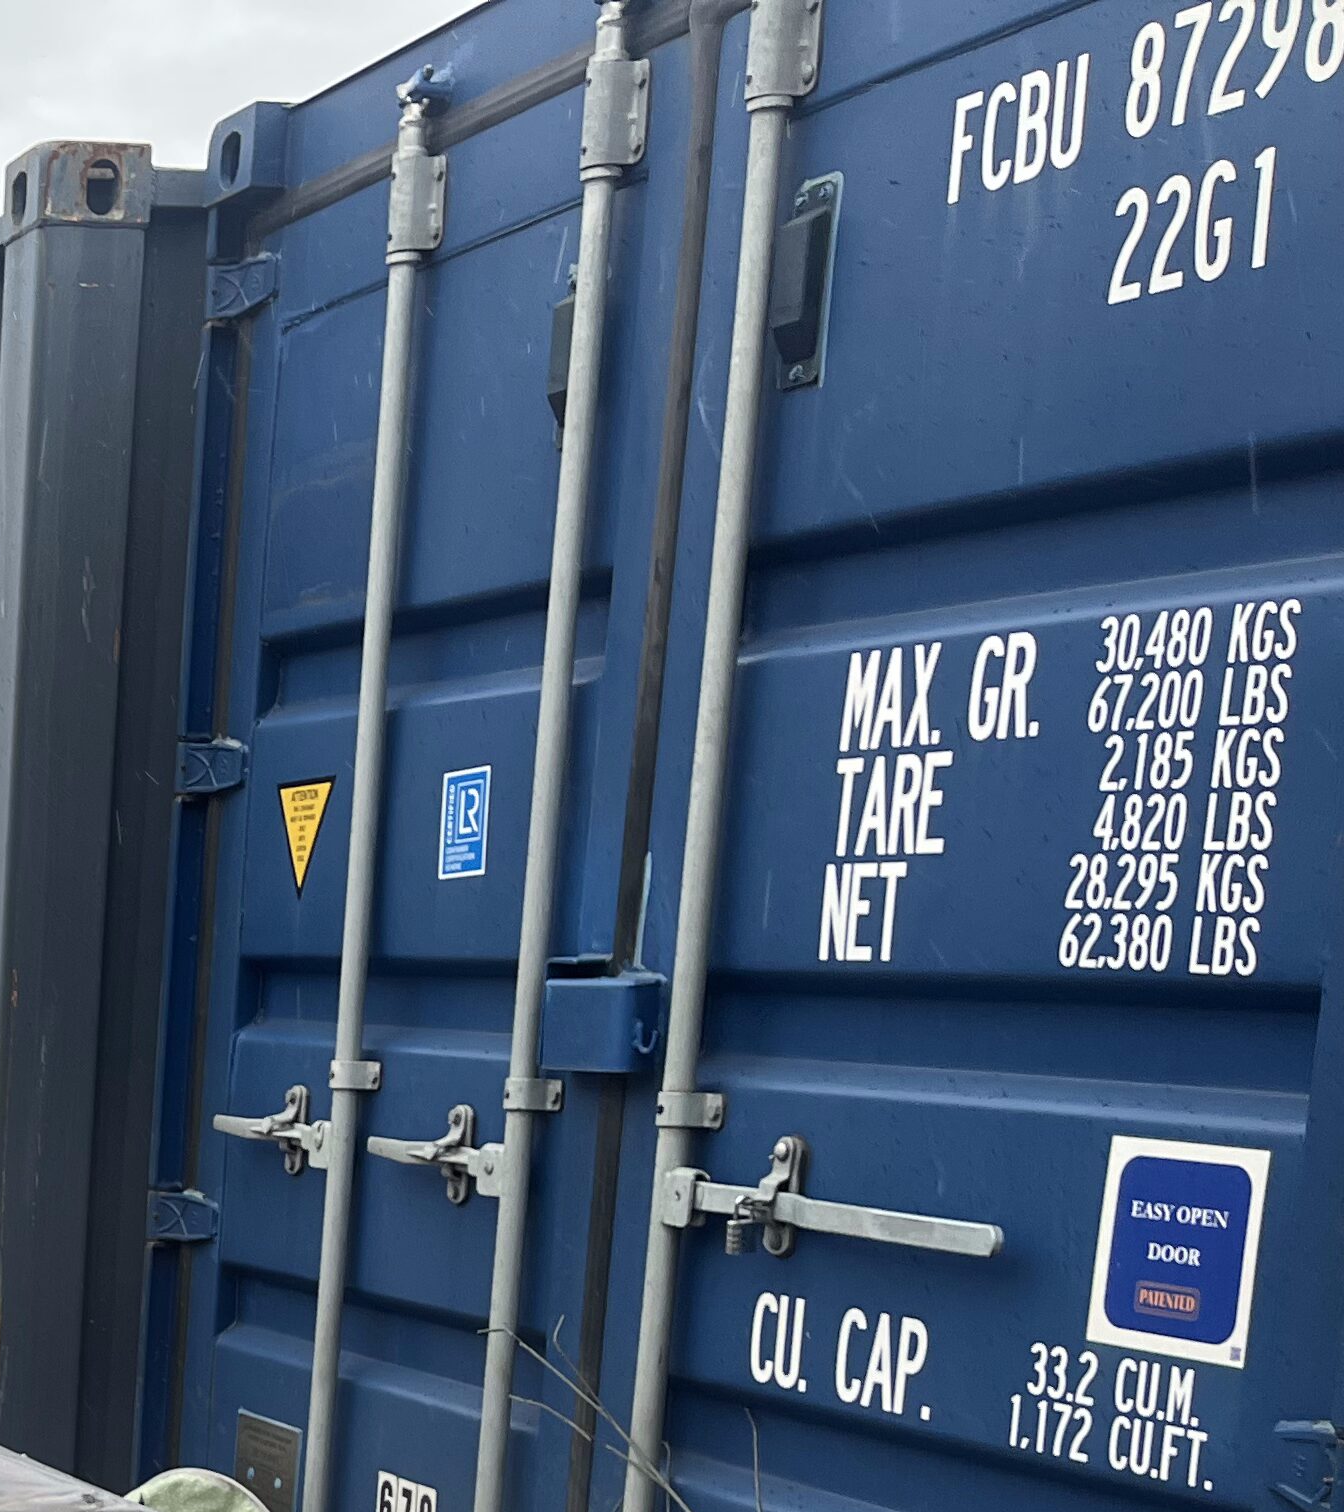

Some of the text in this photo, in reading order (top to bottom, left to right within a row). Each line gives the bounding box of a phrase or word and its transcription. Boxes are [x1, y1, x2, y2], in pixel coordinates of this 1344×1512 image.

[947, 53, 1090, 204] FCBU
[1108, 146, 1277, 305] 22G1
[839, 599, 1302, 752] MAX. GR. 30,480 KGS
[1088, 664, 1293, 732] 67,200 LBS
[835, 727, 1285, 857] TARE 2,185 KGS
[1093, 791, 1277, 851] 4,820 LBS
[818, 853, 1269, 962] NET 28,295 KGS
[1058, 913, 1261, 976] 62,380 LBS
[1131, 1200, 1230, 1230] EASY OPEN
[1147, 1242, 1201, 1268] DOOR
[1139, 1288, 1196, 1313] PATENTED
[750, 1292, 931, 1421] CU. CAP.
[1027, 1342, 1200, 1428] 33.2 CU.M.
[1008, 1394, 1214, 1492] 1,172 CU.FT.
